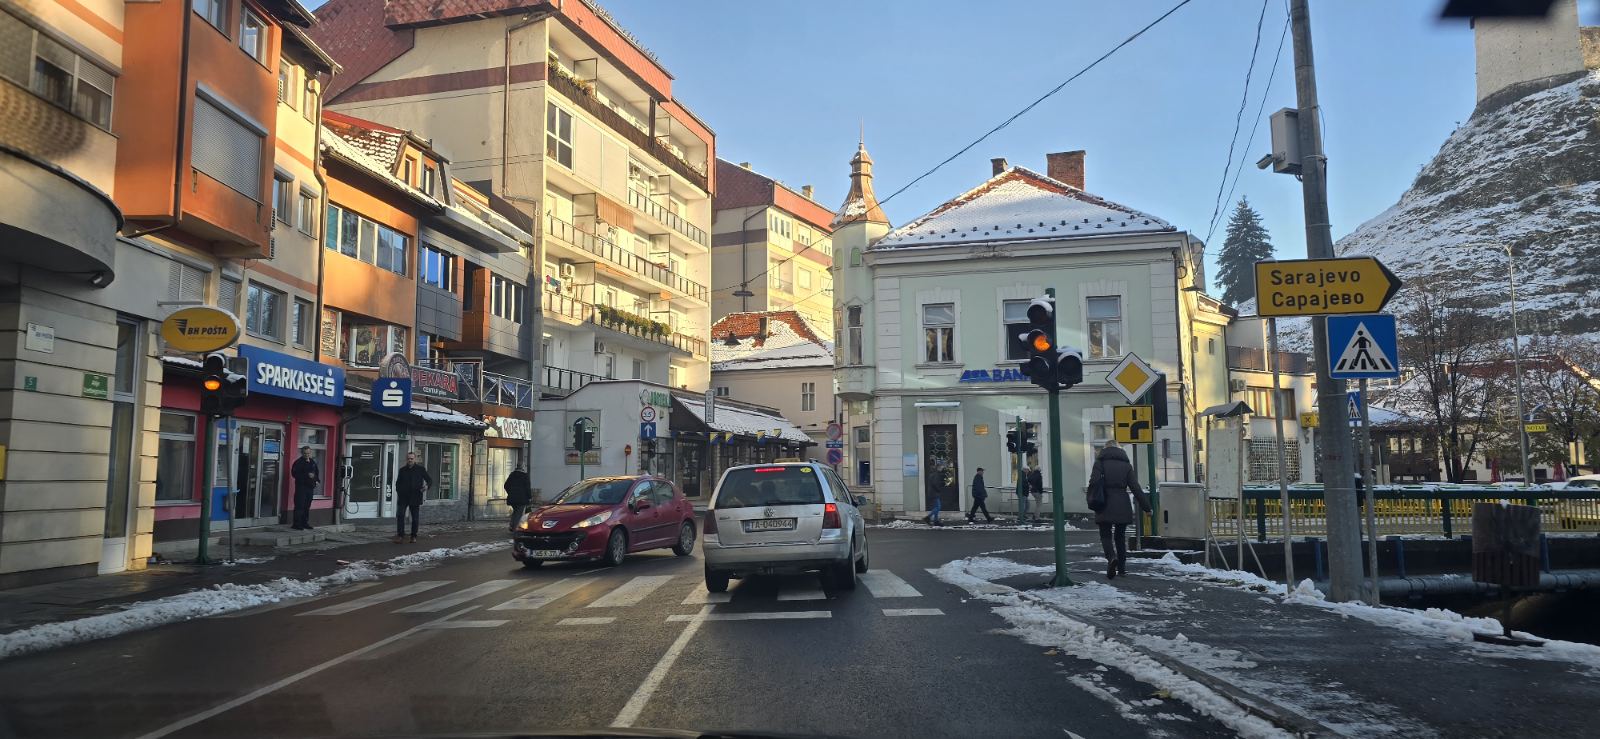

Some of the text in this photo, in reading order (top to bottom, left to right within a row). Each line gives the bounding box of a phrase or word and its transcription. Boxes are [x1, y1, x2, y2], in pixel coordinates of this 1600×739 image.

[1270, 269, 1361, 287] Sarajevo
[1271, 290, 1364, 310] Сарајево
[201, 324, 228, 335] POŠTA
[256, 362, 324, 395] SPARKASSE
[411, 368, 457, 393] PEKARA
[750, 519, 793, 529] TA-040944
